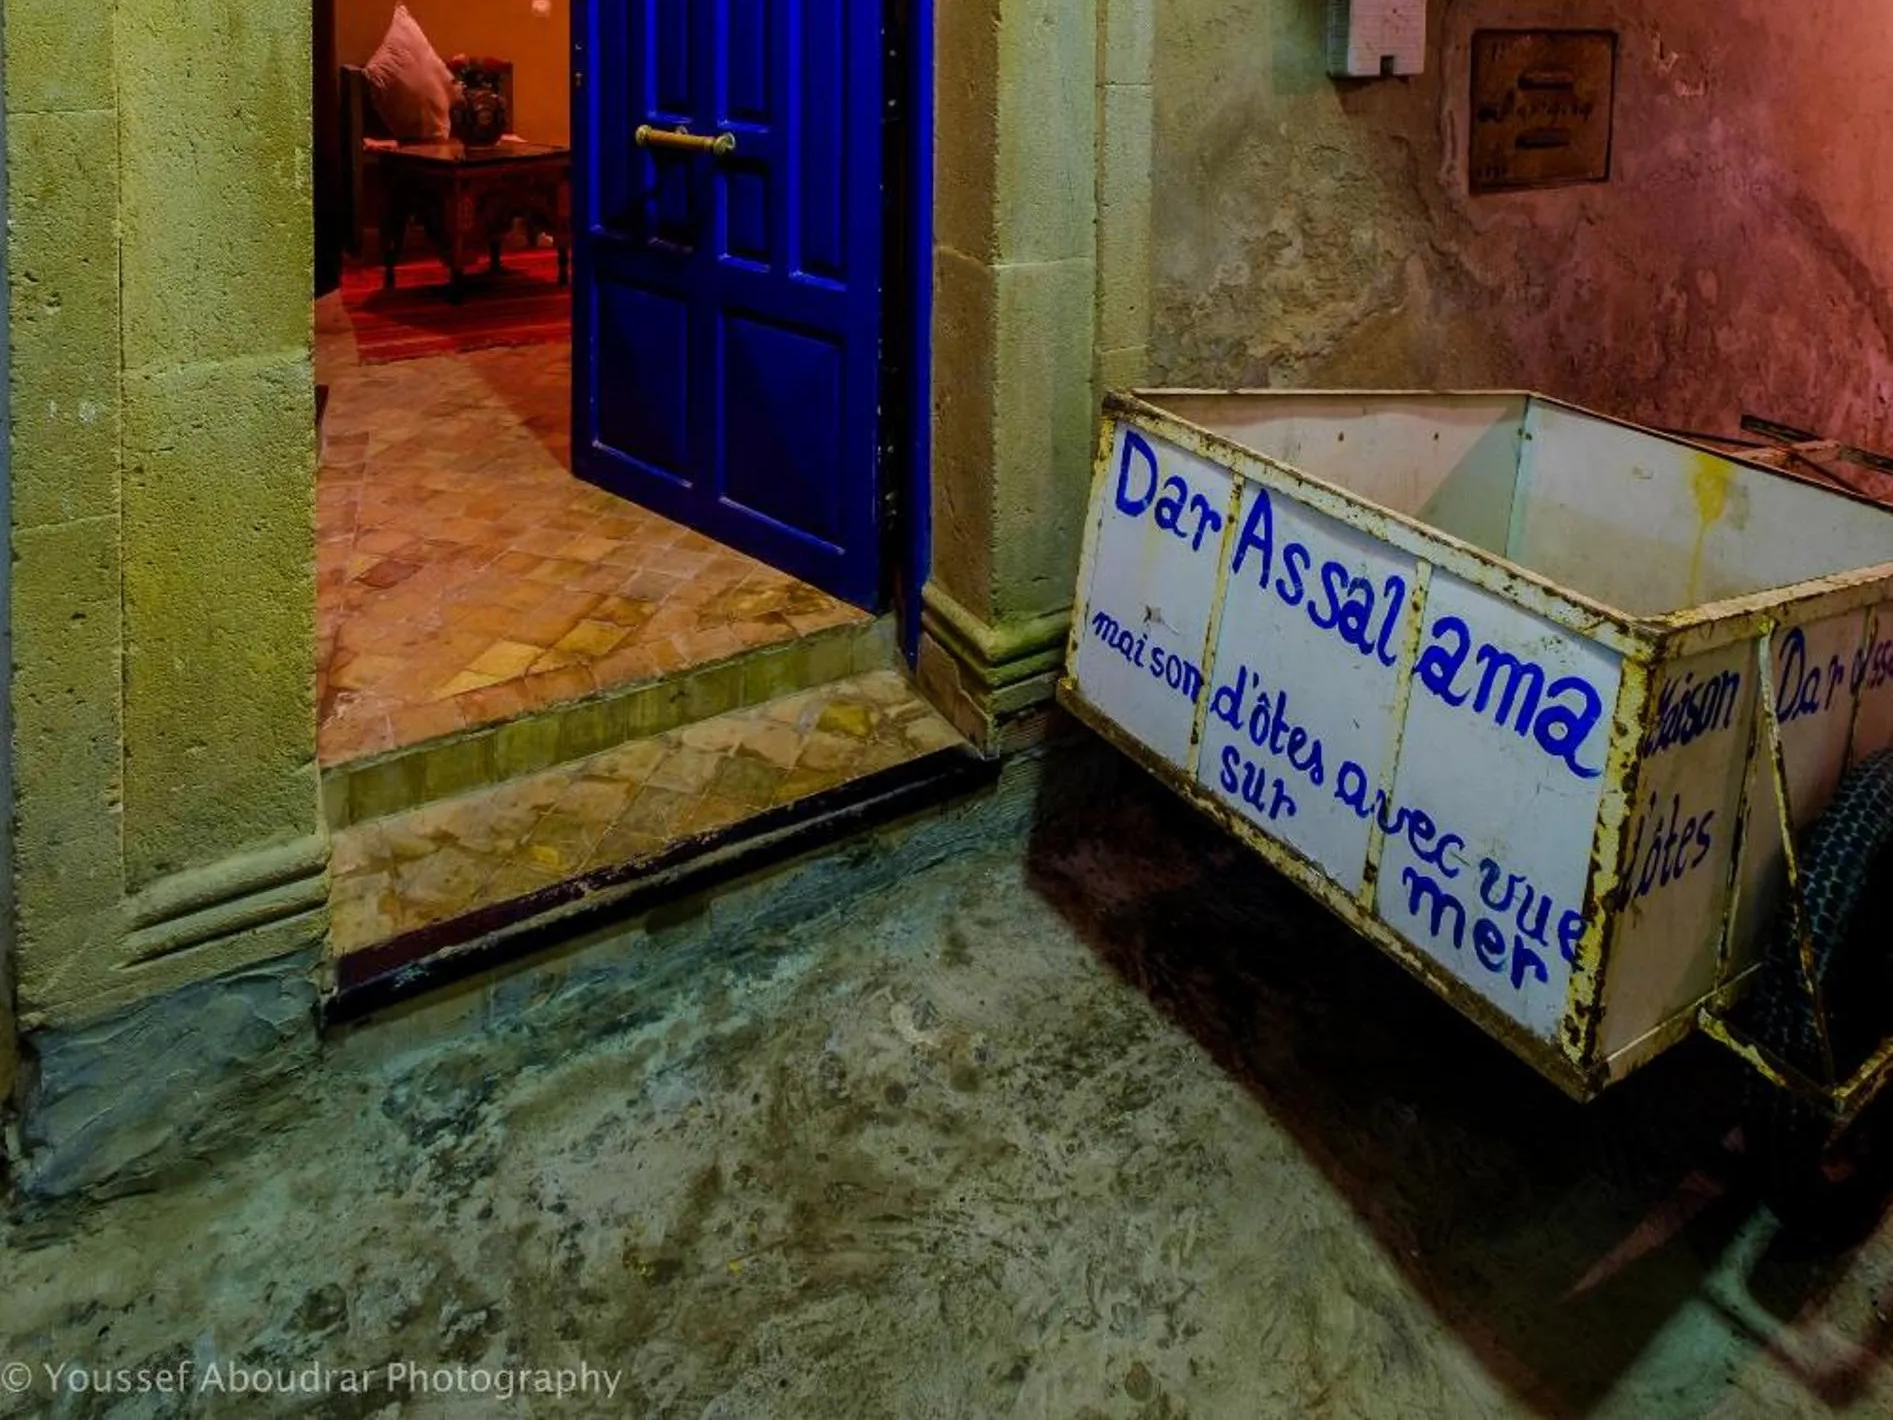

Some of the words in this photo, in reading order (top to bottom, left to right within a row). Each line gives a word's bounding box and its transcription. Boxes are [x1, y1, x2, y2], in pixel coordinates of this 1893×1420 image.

[1115, 430, 1223, 552] Dar
[1775, 626, 1844, 724] Dar
[1092, 611, 1204, 705] maison
[1210, 665, 1324, 786] d'ôtes
[1334, 760, 1465, 879] avec
[1479, 857, 1588, 973] vue
[1220, 745, 1296, 820] sur
[1402, 866, 1549, 990] mer
